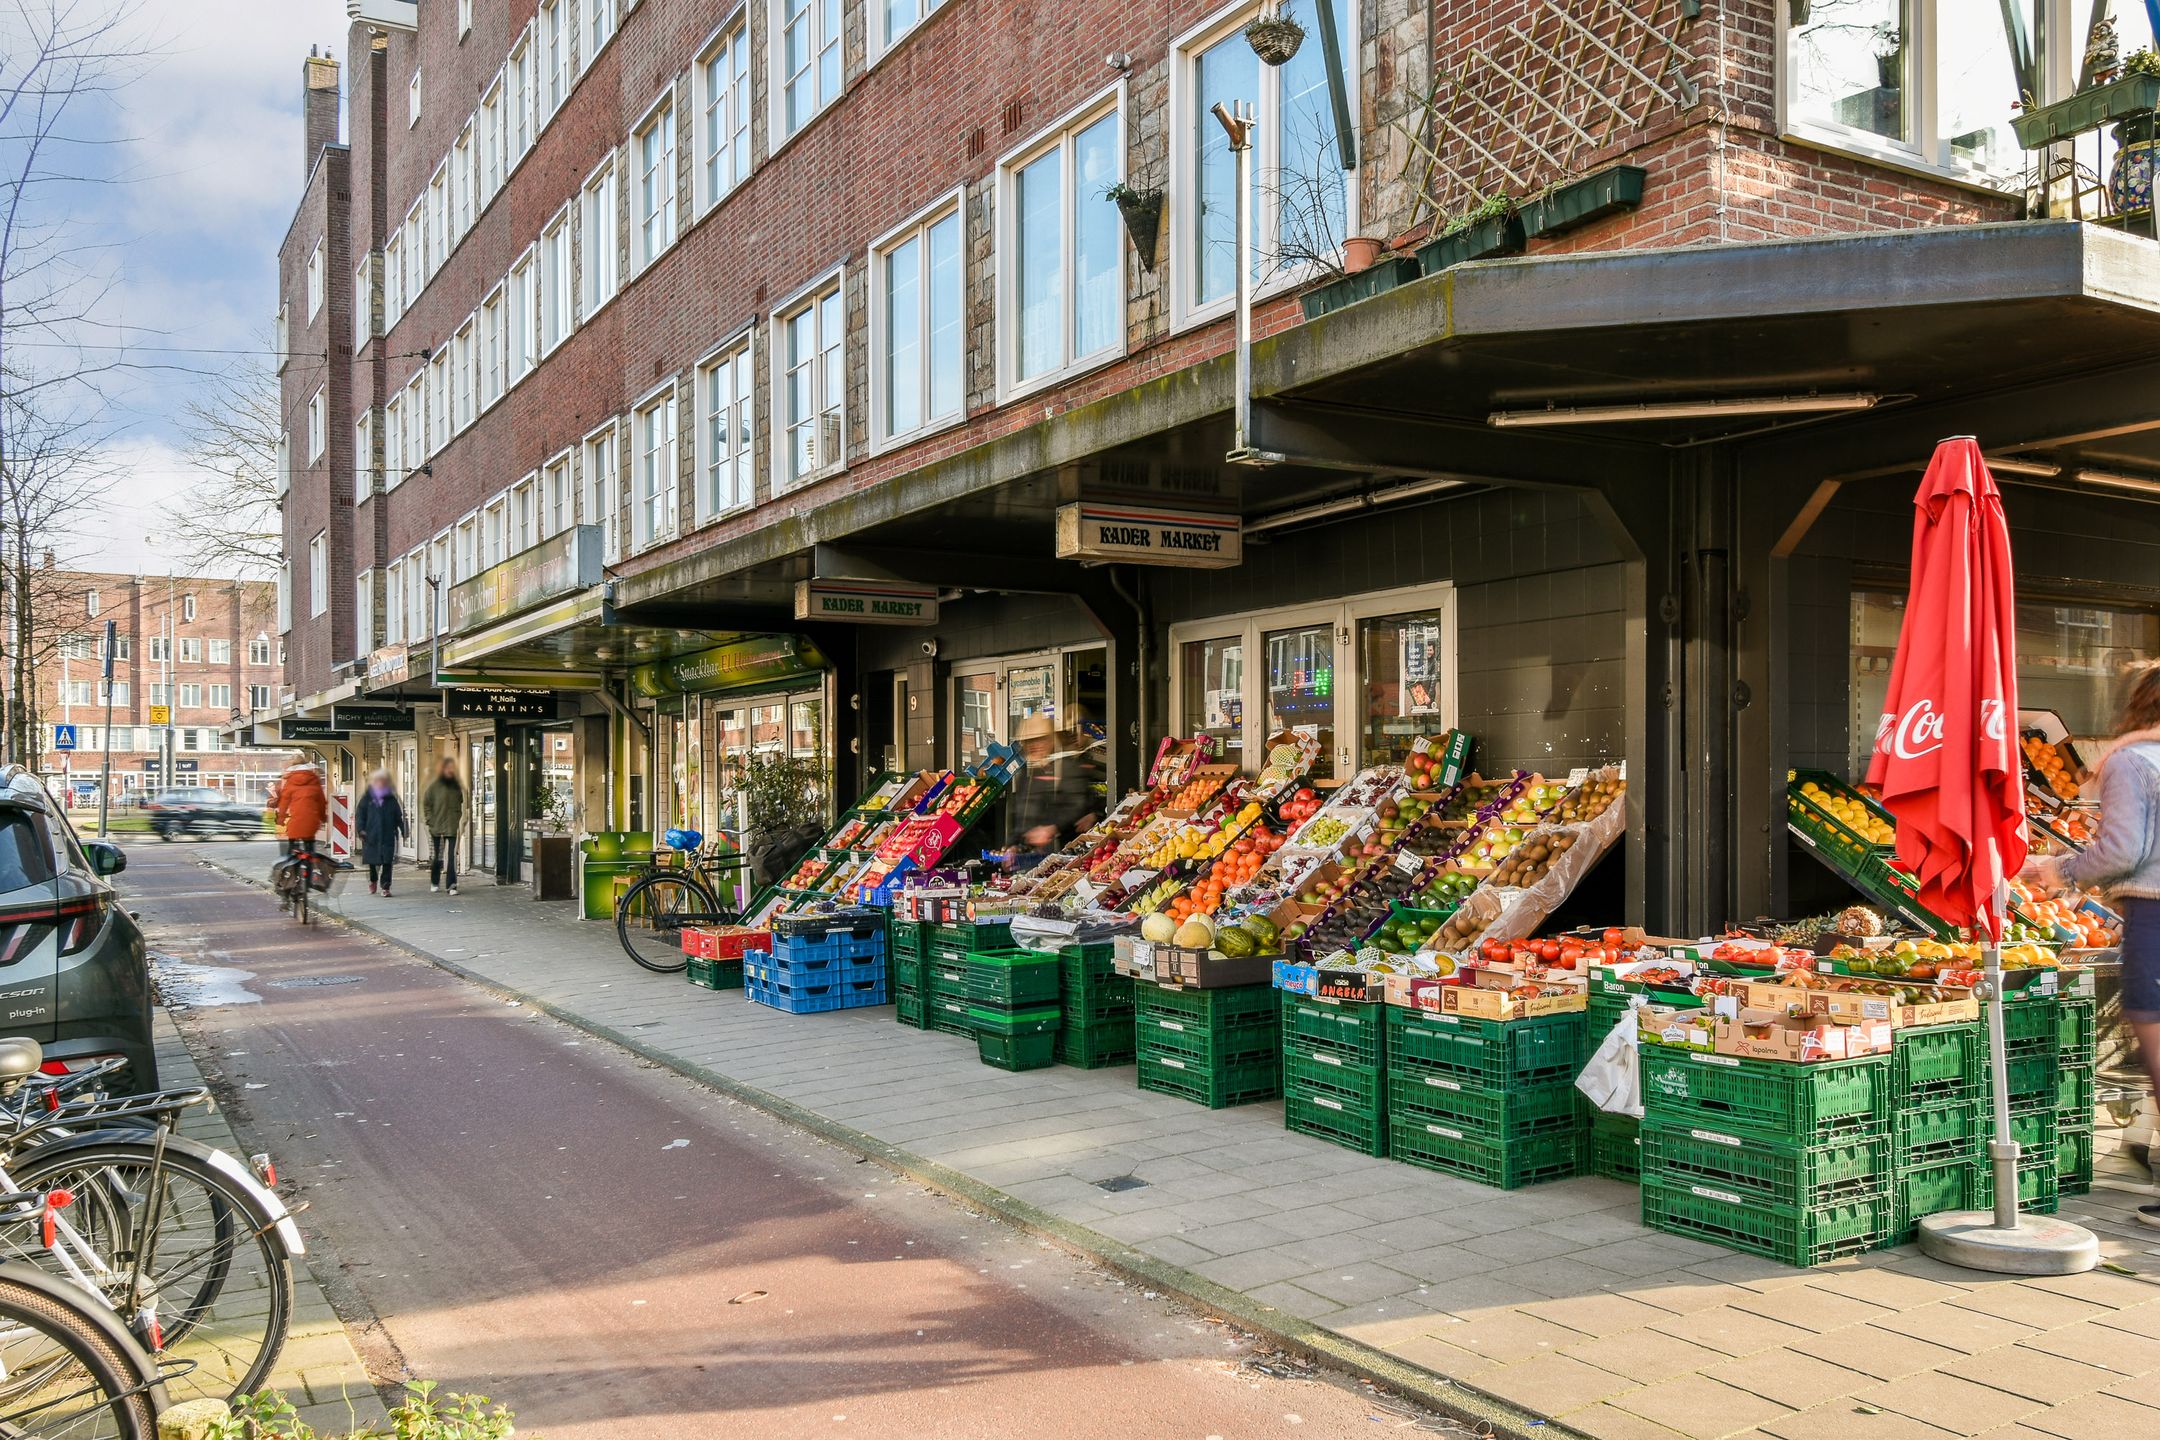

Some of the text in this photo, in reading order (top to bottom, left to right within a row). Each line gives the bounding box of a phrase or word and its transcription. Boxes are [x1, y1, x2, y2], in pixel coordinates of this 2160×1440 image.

[1099, 526, 1221, 552] KADER MARKET
[822, 597, 922, 616] KADER MARKET
[679, 658, 720, 682] Snackbar
[463, 704, 544, 713] NARMIN'S
[910, 695, 917, 711] 9
[1321, 985, 1364, 999] ANGELA
[1603, 981, 1625, 991] Baron
[9, 1006, 46, 1020] plug-in
